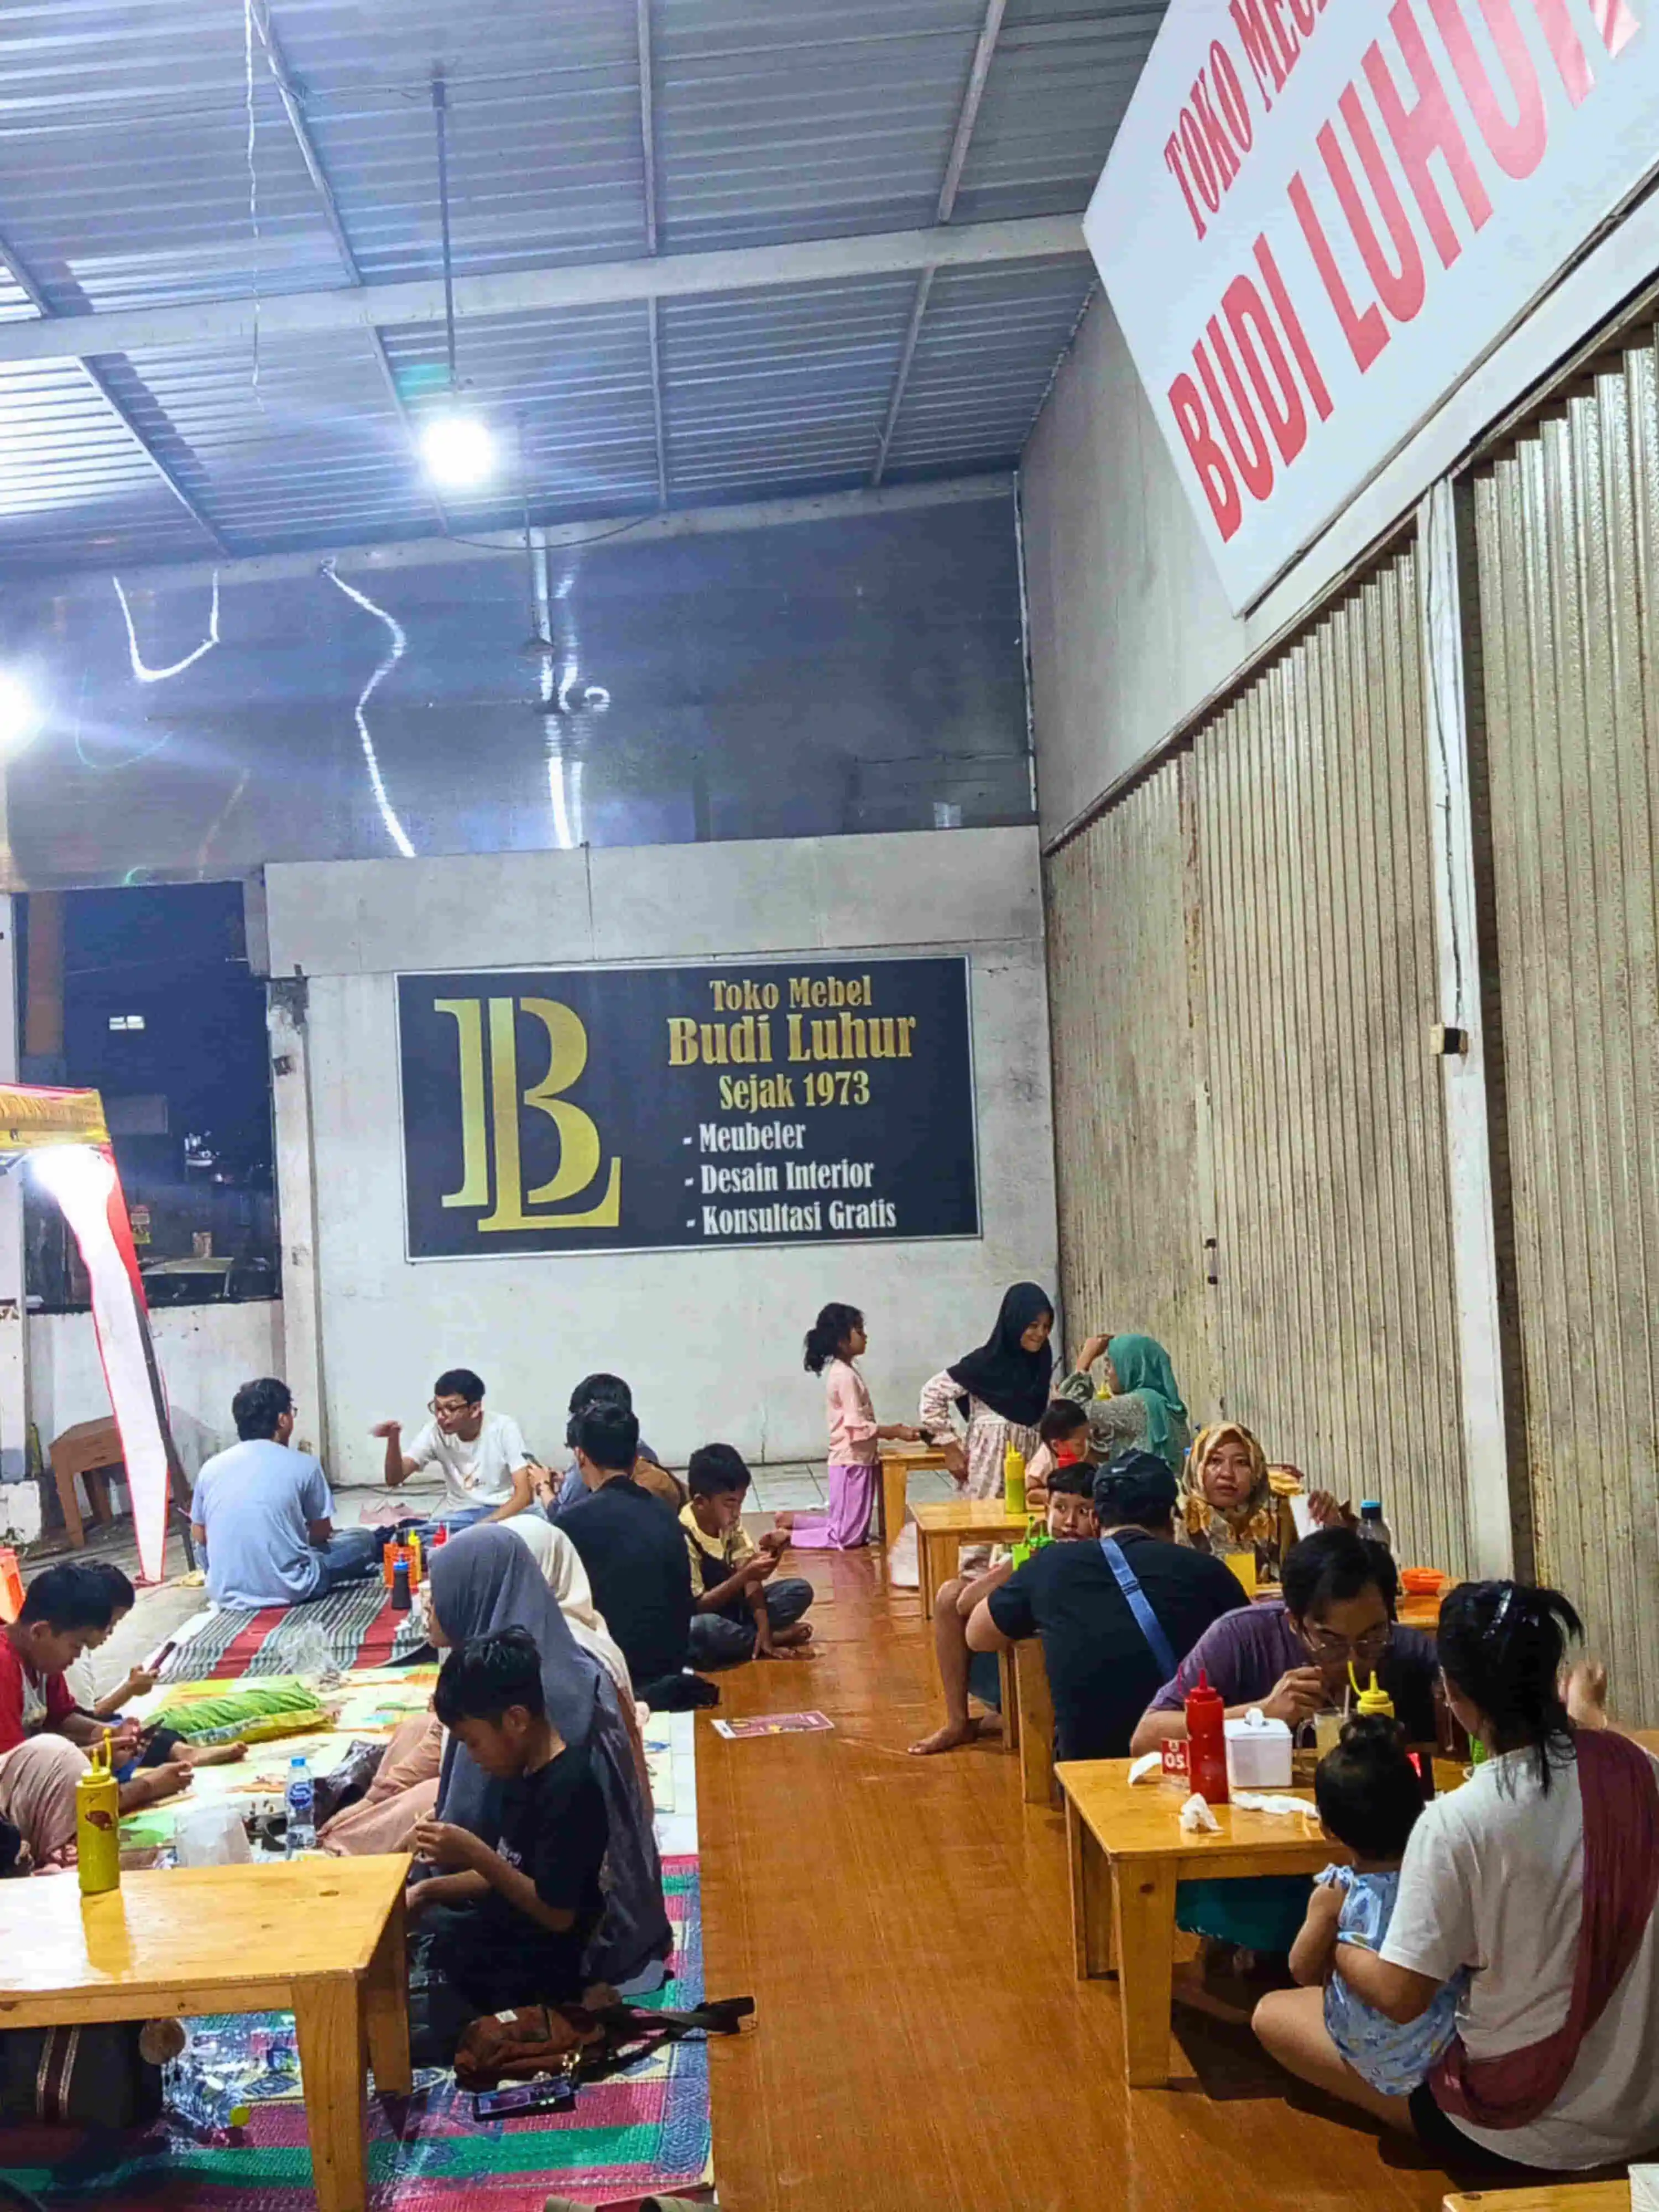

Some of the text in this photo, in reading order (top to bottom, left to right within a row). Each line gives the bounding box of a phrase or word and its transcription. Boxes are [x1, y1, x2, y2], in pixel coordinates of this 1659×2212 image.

[1164, 39, 1253, 242] TOKO
[1167, 231, 1334, 542] BUDI
[710, 975, 872, 1011] Toko Mebel
[667, 1011, 916, 1066] Budi Luhur
[718, 1071, 870, 1114] Sejak 1973
[699, 1121, 806, 1153] Meubeler
[701, 1162, 779, 1194] Desain
[785, 1159, 874, 1190] Interior
[702, 1204, 822, 1235] Konsultasi
[828, 1199, 897, 1230] Gratis
